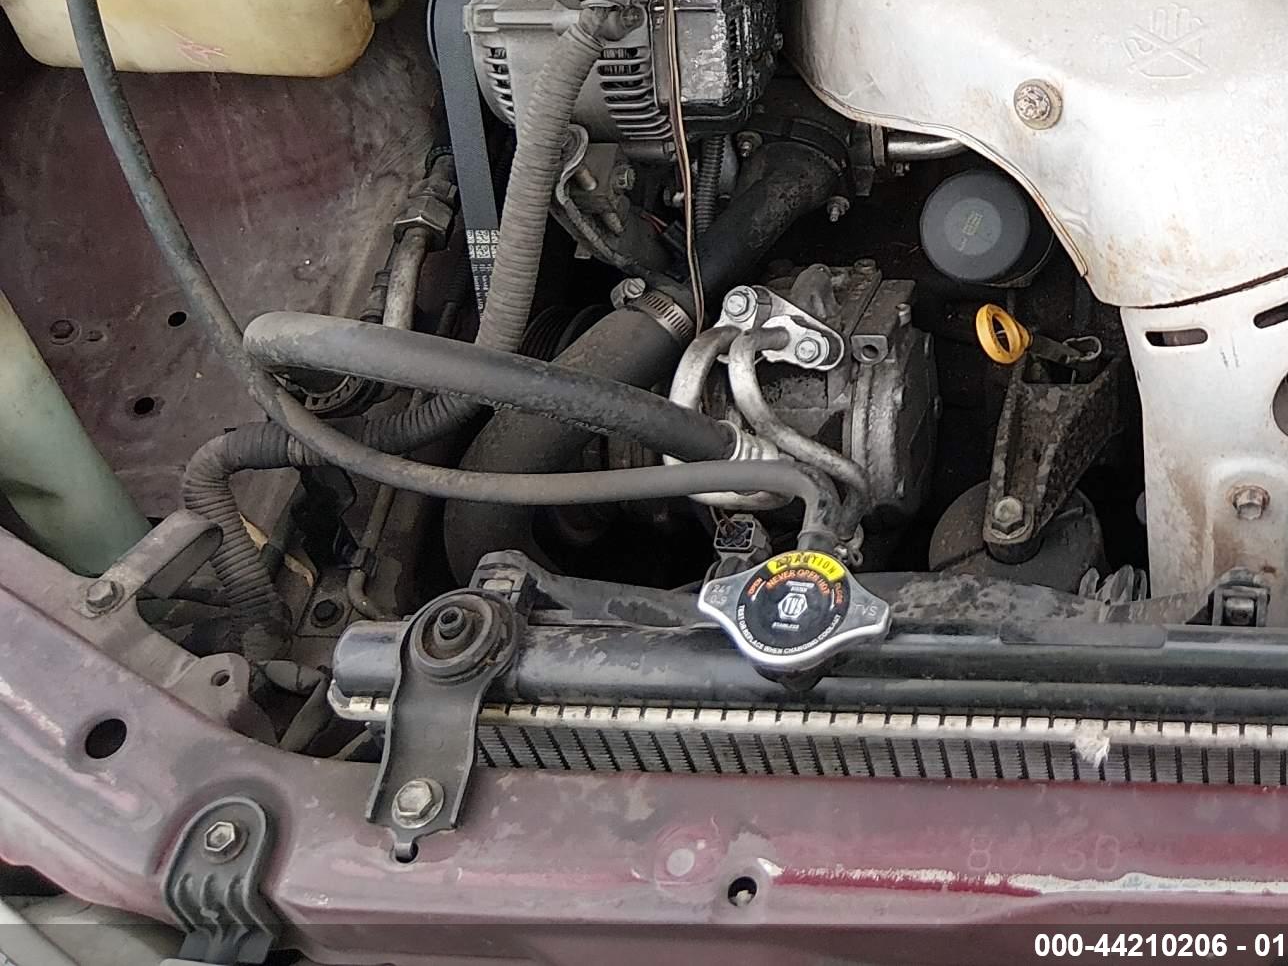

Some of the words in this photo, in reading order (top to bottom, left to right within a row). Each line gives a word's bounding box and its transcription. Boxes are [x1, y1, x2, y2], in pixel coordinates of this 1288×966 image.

[784, 553, 838, 575] CAUTION
[766, 569, 797, 590] NEVER
[797, 569, 821, 585] OPEN
[783, 596, 807, 616] TVS
[854, 603, 878, 617] TVS
